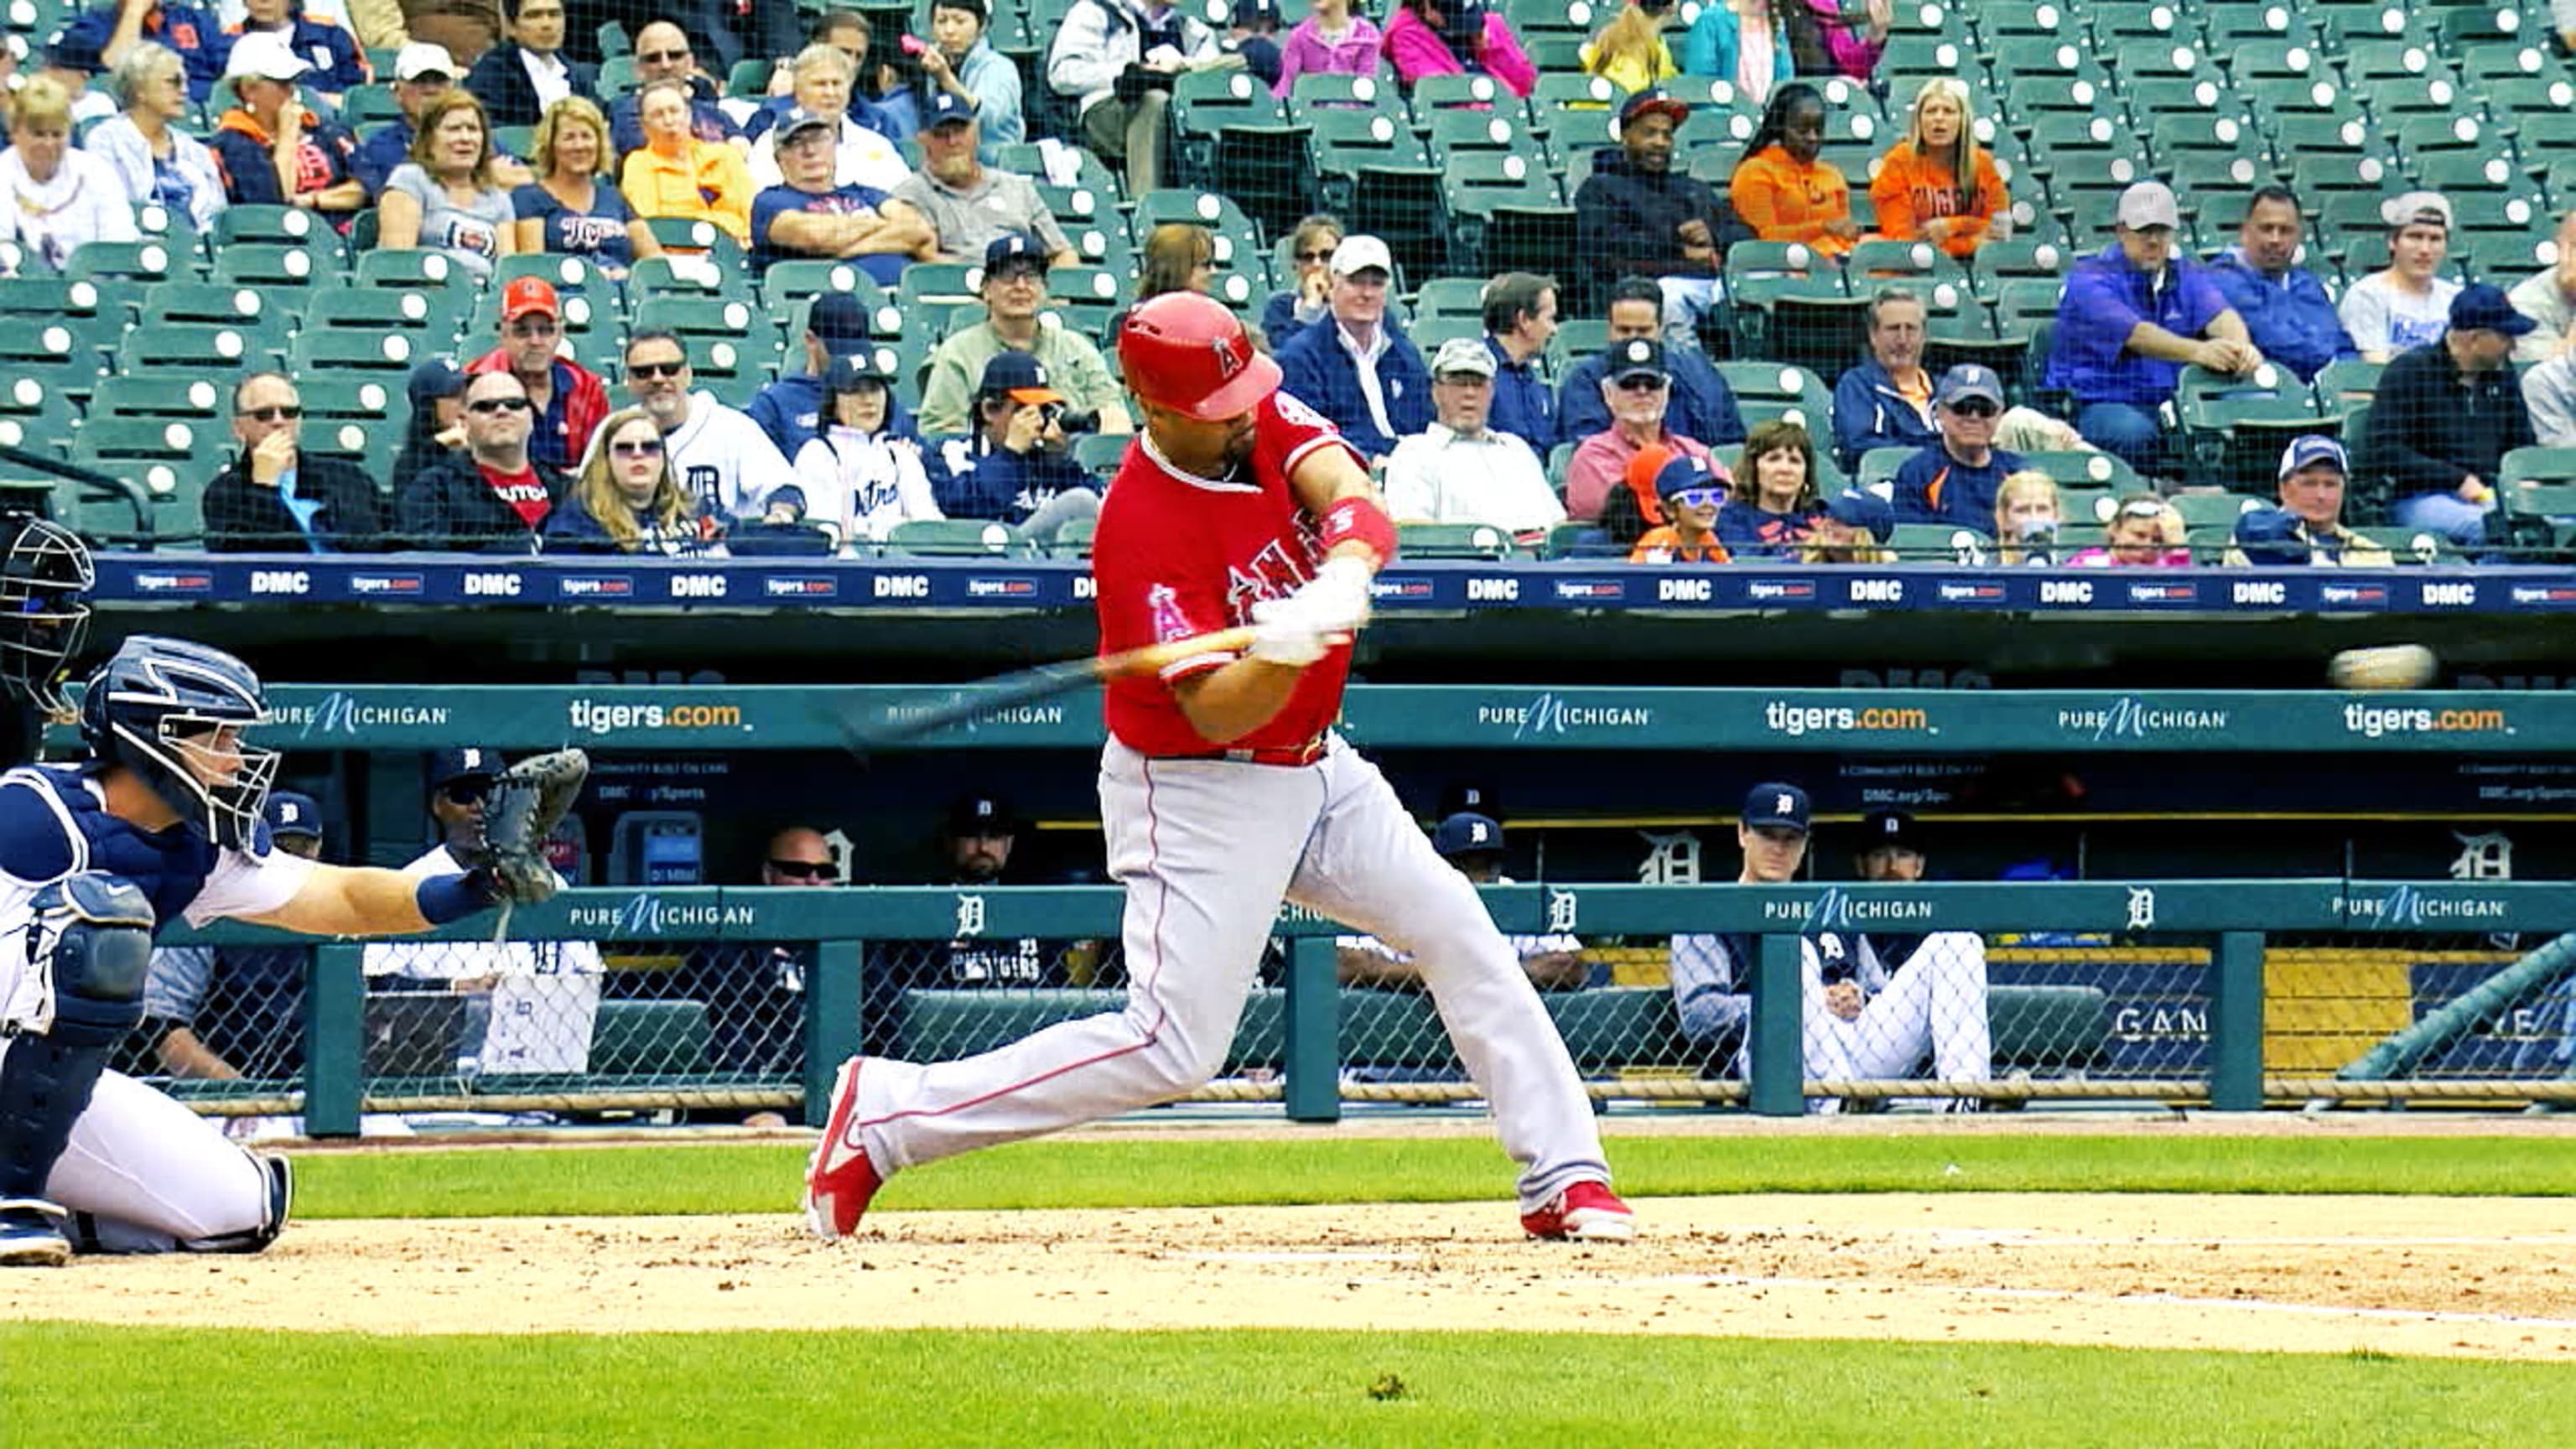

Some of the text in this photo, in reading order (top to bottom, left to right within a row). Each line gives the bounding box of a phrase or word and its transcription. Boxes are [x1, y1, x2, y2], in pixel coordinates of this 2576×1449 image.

[1213, 336, 1243, 378] A
[251, 571, 310, 594] DMC
[465, 574, 522, 595] DMC
[671, 575, 726, 596] DMC
[874, 576, 928, 597] DMC
[1467, 579, 1519, 600] DMC
[1659, 579, 1711, 600] DMC
[1851, 580, 1903, 601] DMC
[2040, 582, 2093, 603] DMC
[2233, 583, 2285, 603] DMC
[2423, 584, 2475, 605] DMC
[269, 692, 448, 739] URE MICHIGAN
[569, 699, 741, 734] tigers.com
[1478, 692, 1648, 740] PURE MICHIGAN
[1766, 701, 1926, 735] tigers.com
[2058, 697, 2225, 741] PURE MICHIGAN
[2344, 704, 2504, 737] tigers.com
[570, 892, 754, 938] PURE MICHIGAN
[955, 893, 985, 937] D
[1547, 889, 1577, 932] D
[1764, 886, 1931, 931] PURE MICHIGAN
[2126, 886, 2155, 931] D
[2332, 886, 2503, 928] PURE MICHIGAN
